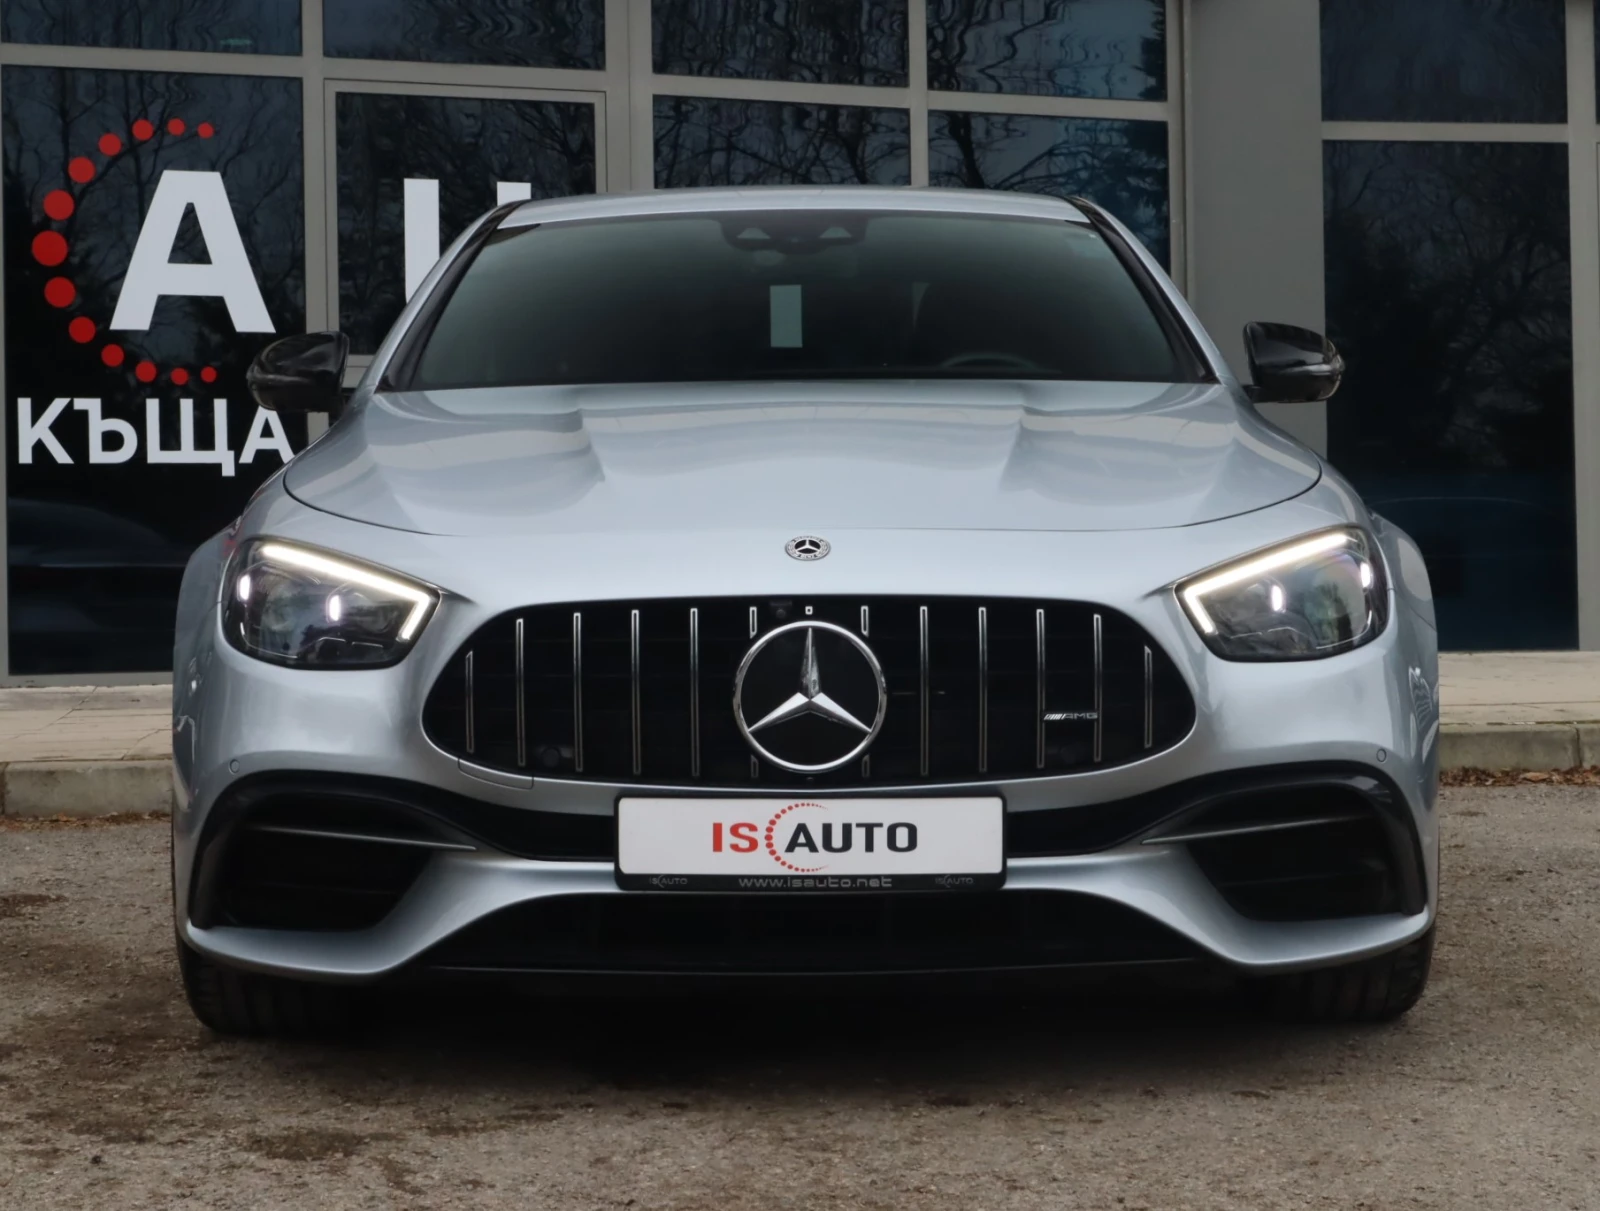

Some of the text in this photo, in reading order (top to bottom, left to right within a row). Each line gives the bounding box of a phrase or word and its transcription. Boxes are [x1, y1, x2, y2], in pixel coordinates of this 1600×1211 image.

[712, 822, 918, 853] IS AUTO
[738, 876, 892, 888] www.isauto.net
